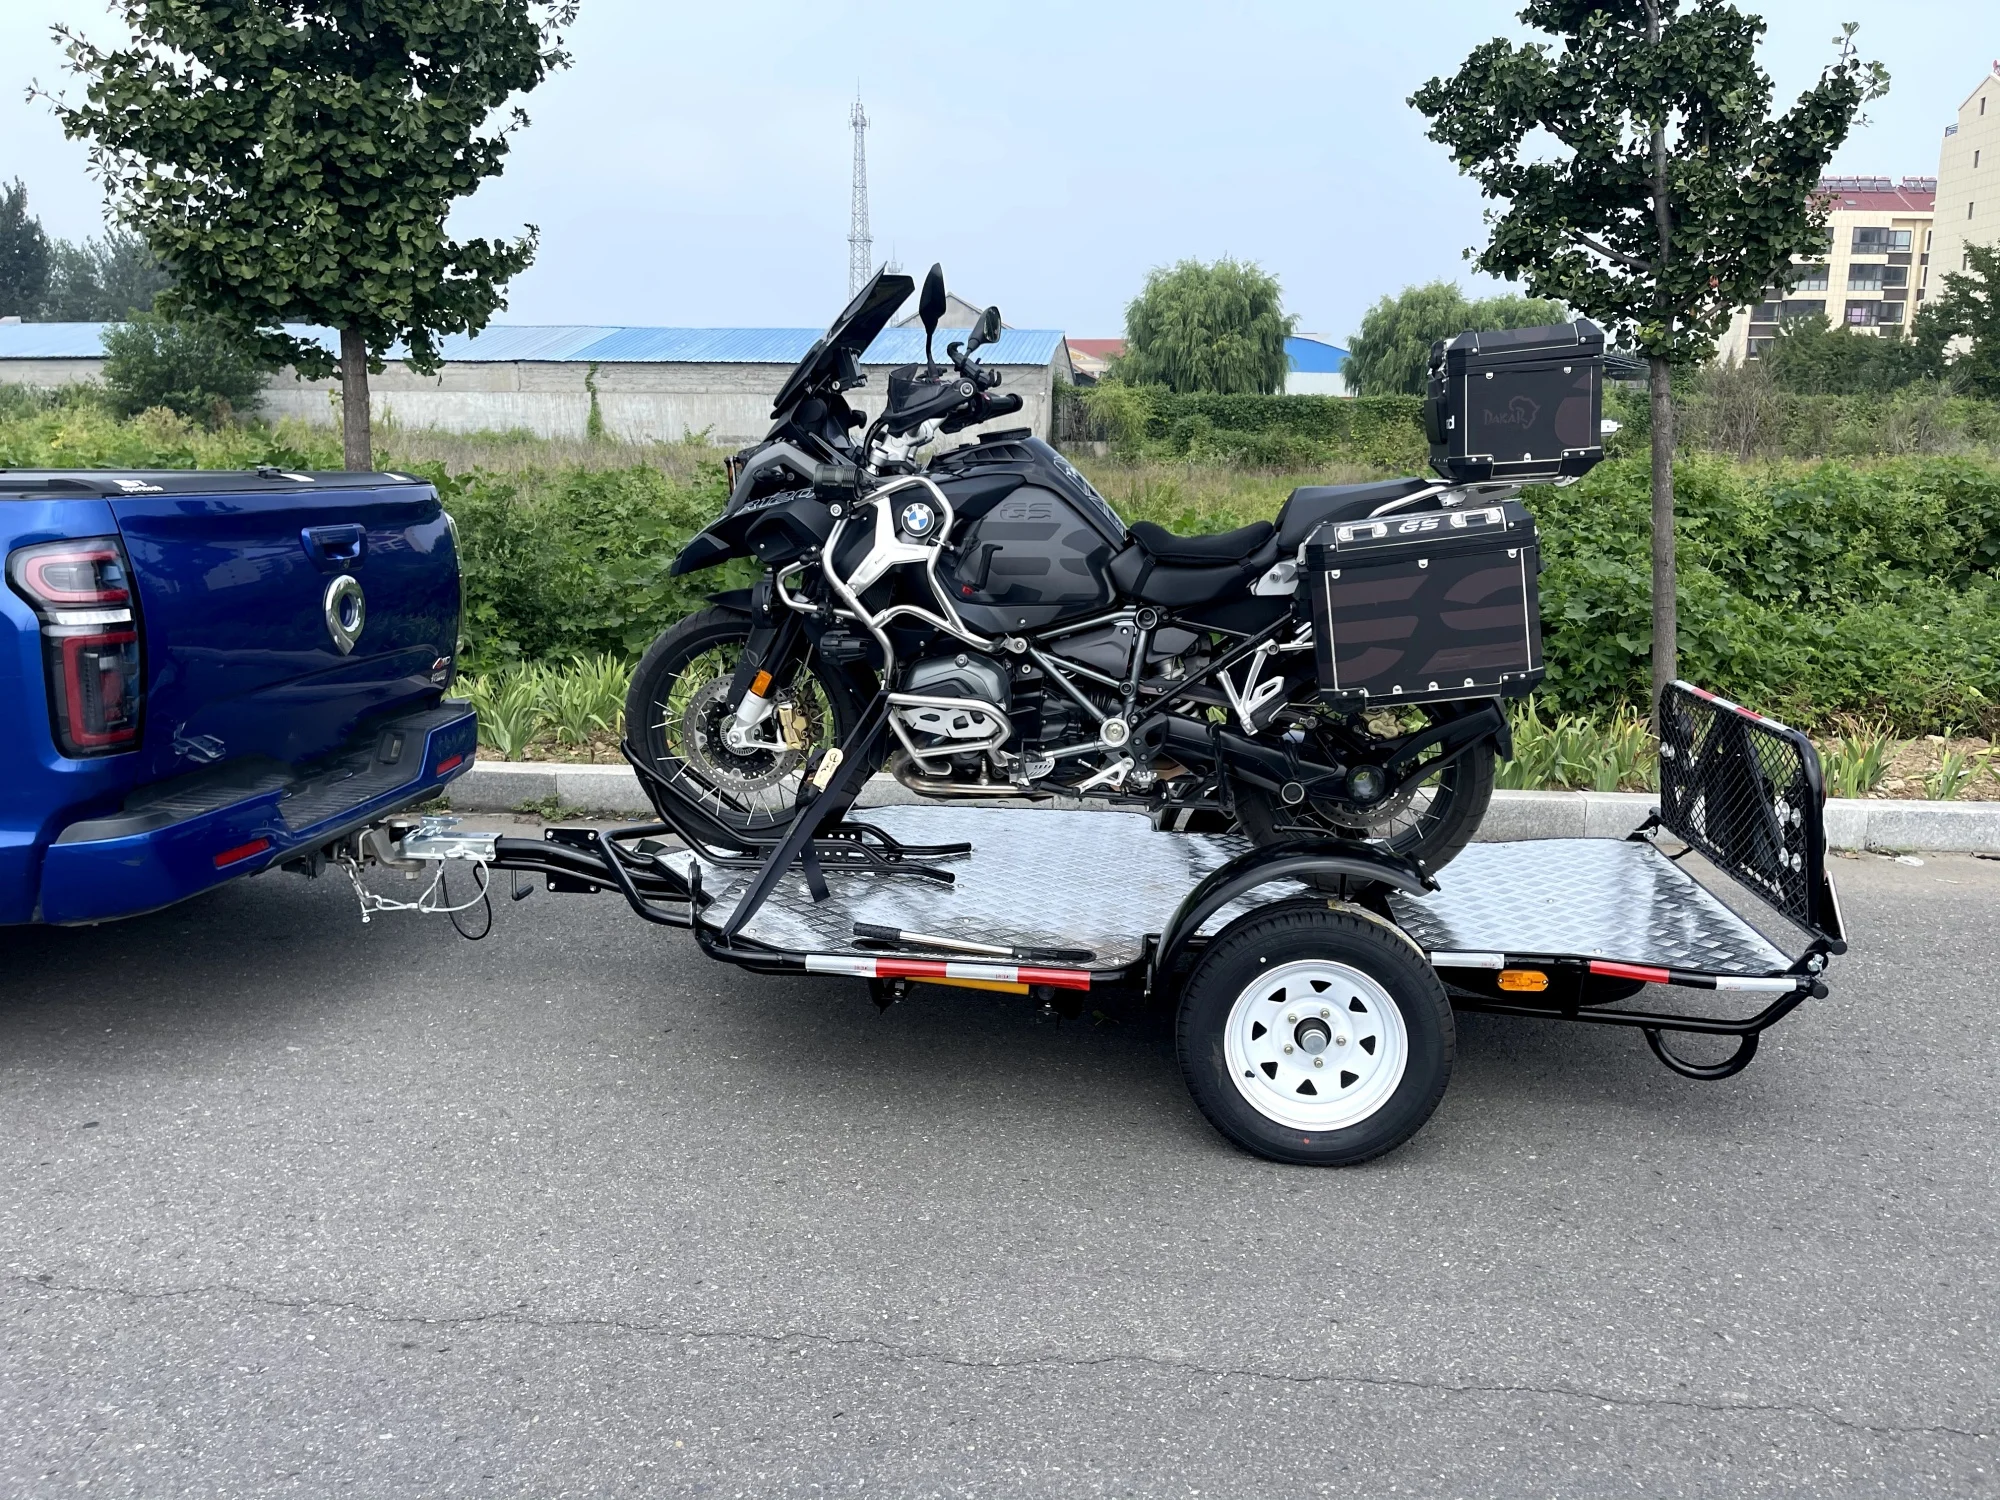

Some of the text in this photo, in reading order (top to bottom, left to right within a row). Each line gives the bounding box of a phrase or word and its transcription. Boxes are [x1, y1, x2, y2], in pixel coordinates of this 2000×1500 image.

[1482, 407, 1529, 426] DAKAR
[1000, 503, 1052, 520] GS
[1398, 518, 1440, 534] GS
